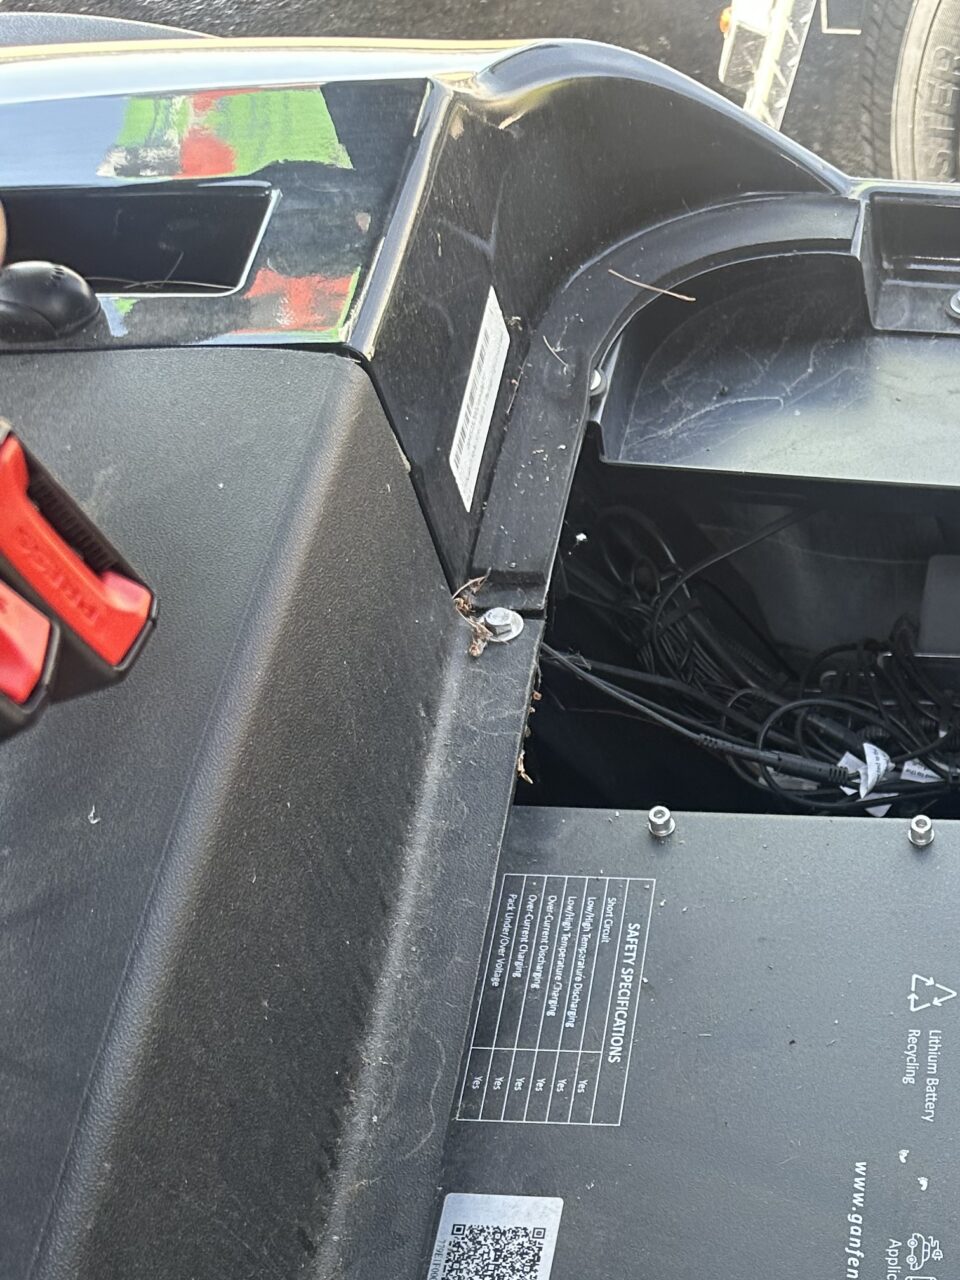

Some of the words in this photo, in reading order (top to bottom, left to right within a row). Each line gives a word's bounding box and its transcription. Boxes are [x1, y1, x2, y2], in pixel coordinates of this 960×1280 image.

[506, 894, 517, 911] Pack
[519, 895, 537, 943] Over-Current
[539, 895, 557, 943] Over-Current
[561, 896, 577, 931] Low/High
[581, 897, 596, 932] Low/High
[603, 898, 617, 916] Short
[497, 913, 515, 957] Under/Over
[600, 918, 613, 943] Circuit
[622, 923, 641, 965] SAFETY
[490, 958, 506, 987] Voltage
[512, 944, 529, 978] Charging
[530, 945, 549, 989] Discharging
[554, 933, 572, 981] Temperature
[574, 933, 592, 982] Temperature
[546, 982, 562, 1016] Charging
[565, 983, 582, 1028] Discharging
[607, 968, 634, 1063] SPECIFICATIONS
[901, 1029, 920, 1084] Recycling
[925, 1029, 943, 1074] Lithium
[471, 1075, 483, 1089] Yes
[492, 1076, 505, 1090] Yes
[514, 1077, 526, 1091] Yes
[535, 1078, 546, 1092] Yes
[556, 1079, 567, 1092] Yes
[576, 1079, 589, 1093] Yes
[920, 1078, 941, 1122] Battery
